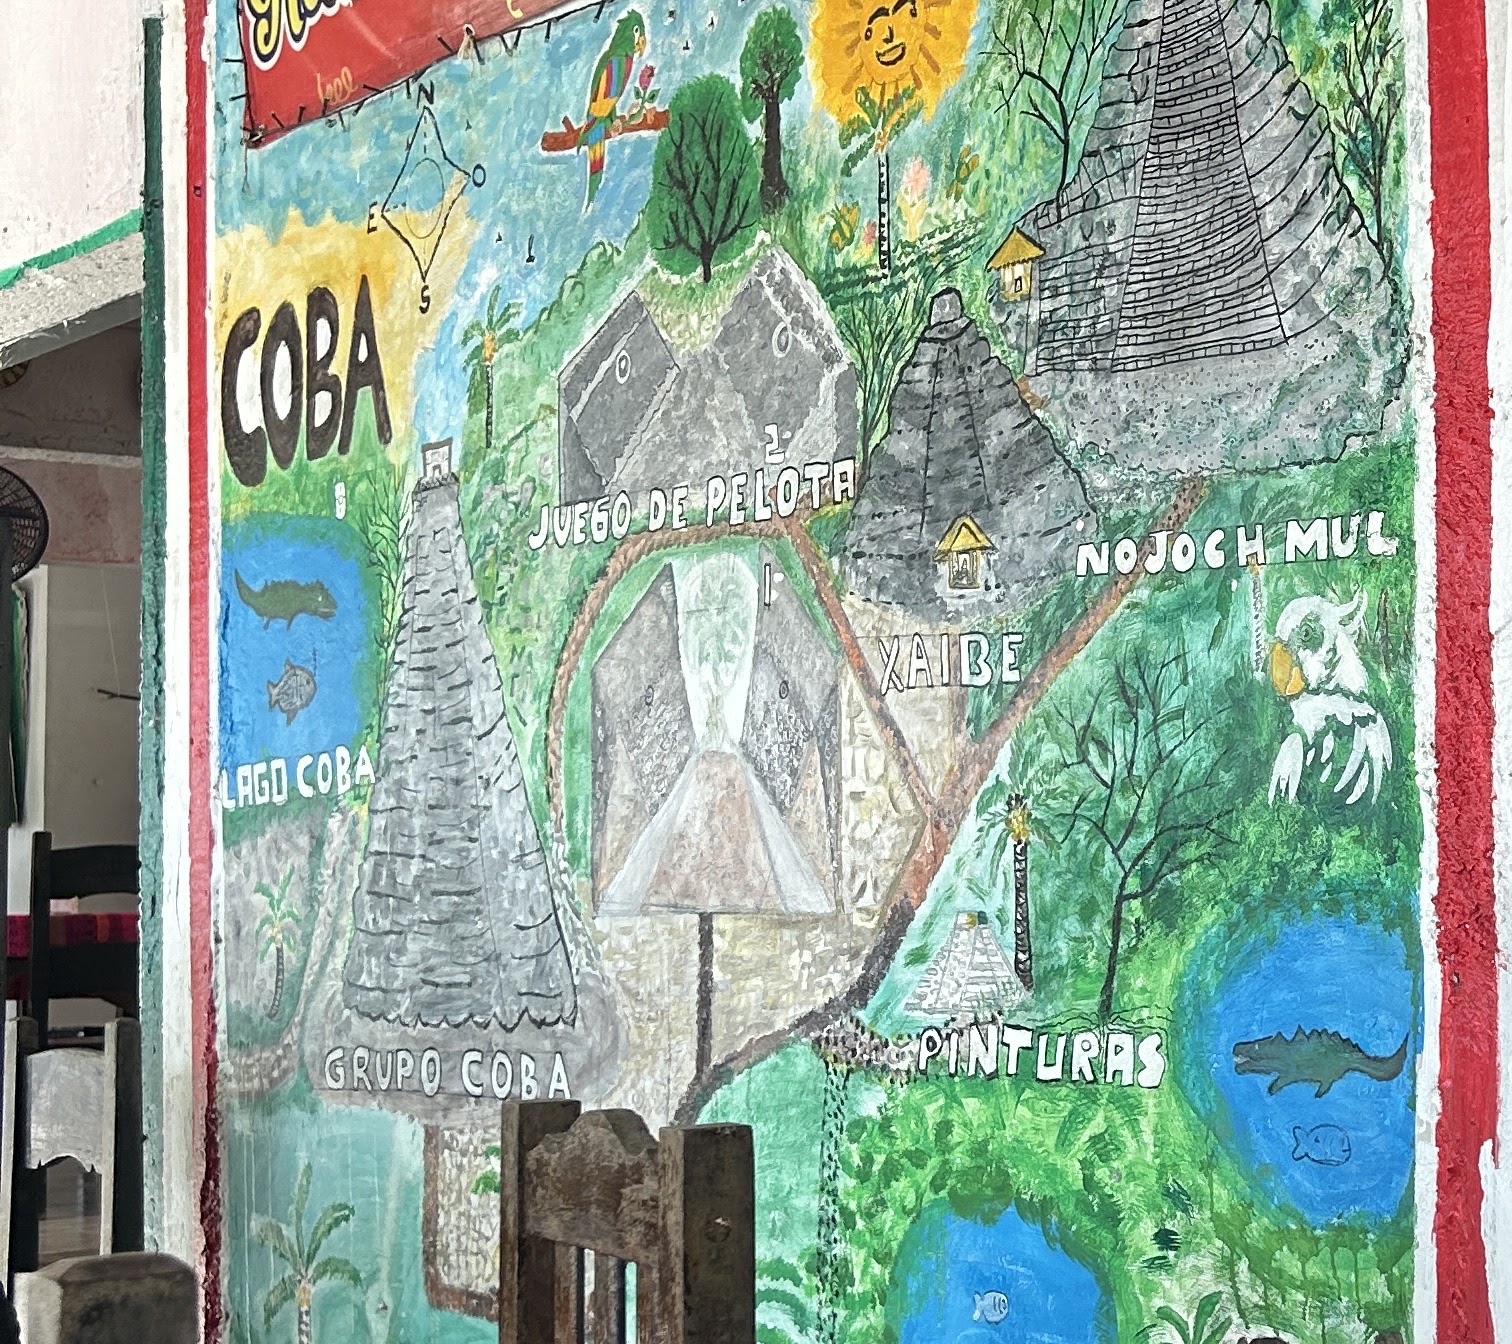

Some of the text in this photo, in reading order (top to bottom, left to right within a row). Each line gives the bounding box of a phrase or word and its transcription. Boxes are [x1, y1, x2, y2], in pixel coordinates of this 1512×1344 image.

[366, 201, 379, 234] E
[418, 285, 431, 315] S
[221, 274, 392, 487] COBA
[528, 456, 857, 551] JUEGO DE PELOTA
[1075, 510, 1399, 578] NOJOCH MUL
[878, 632, 1025, 697] XAIBE
[220, 744, 376, 810] LAGO COBA
[324, 1047, 572, 1101] GRUPO COBA
[918, 1021, 1167, 1090] PINTURAS
